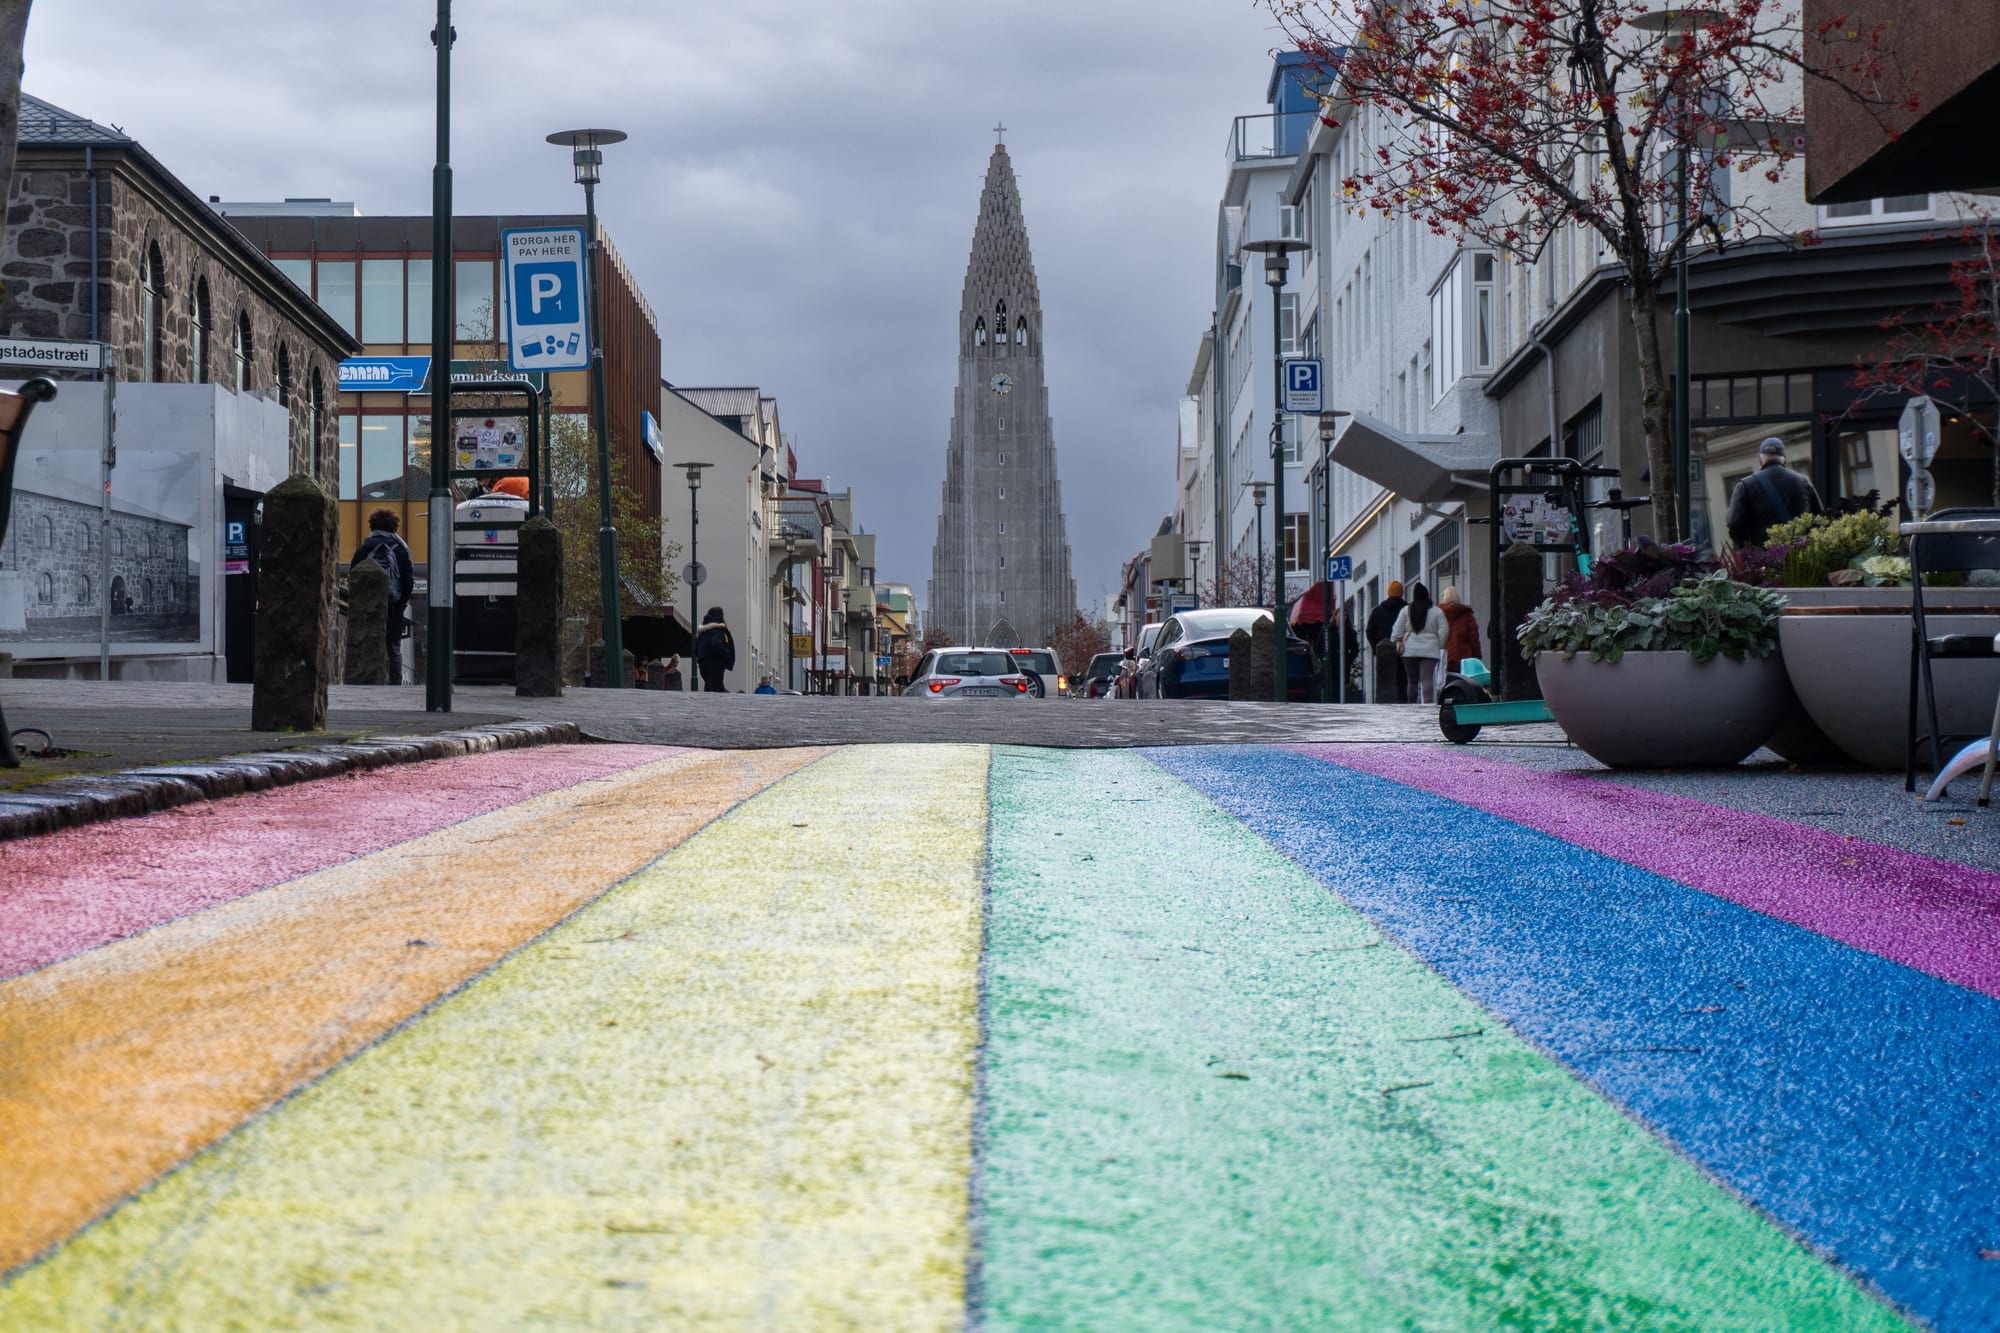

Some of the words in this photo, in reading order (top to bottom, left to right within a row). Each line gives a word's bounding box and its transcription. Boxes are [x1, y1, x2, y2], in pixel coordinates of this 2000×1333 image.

[512, 236, 550, 246] BORGA
[519, 247, 538, 256] PAY
[542, 247, 571, 256] HERE
[339, 366, 389, 380] enninn
[1330, 560, 1339, 579] P
